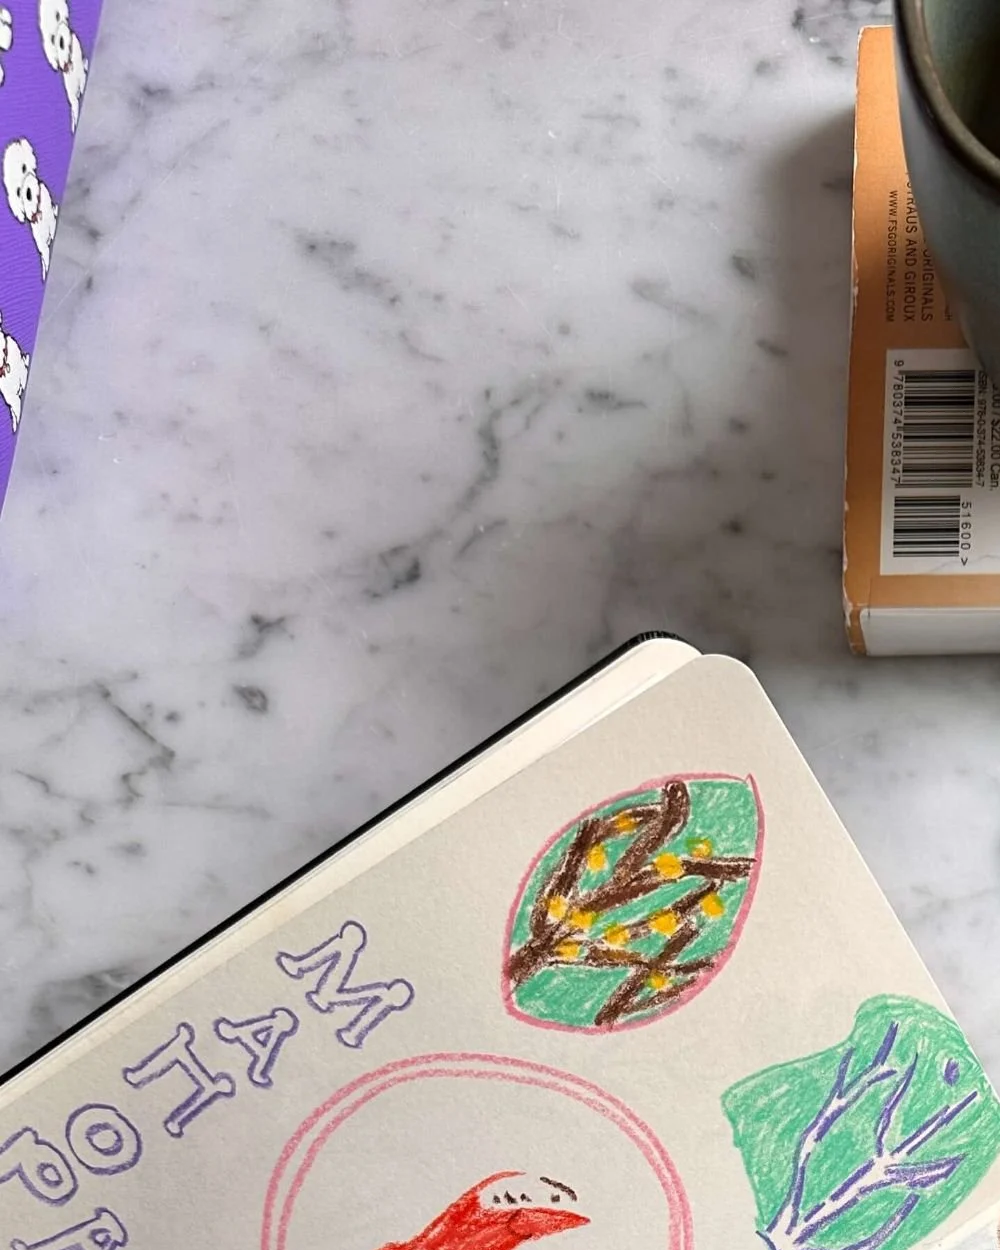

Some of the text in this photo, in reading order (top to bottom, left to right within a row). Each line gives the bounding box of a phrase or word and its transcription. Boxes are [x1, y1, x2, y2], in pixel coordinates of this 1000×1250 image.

[885, 190, 898, 322] WWW.FSGORIGINALS.COM
[904, 238, 917, 322] AND GIROUX
[892, 375, 904, 424] 780374
[890, 433, 901, 483] 538347
